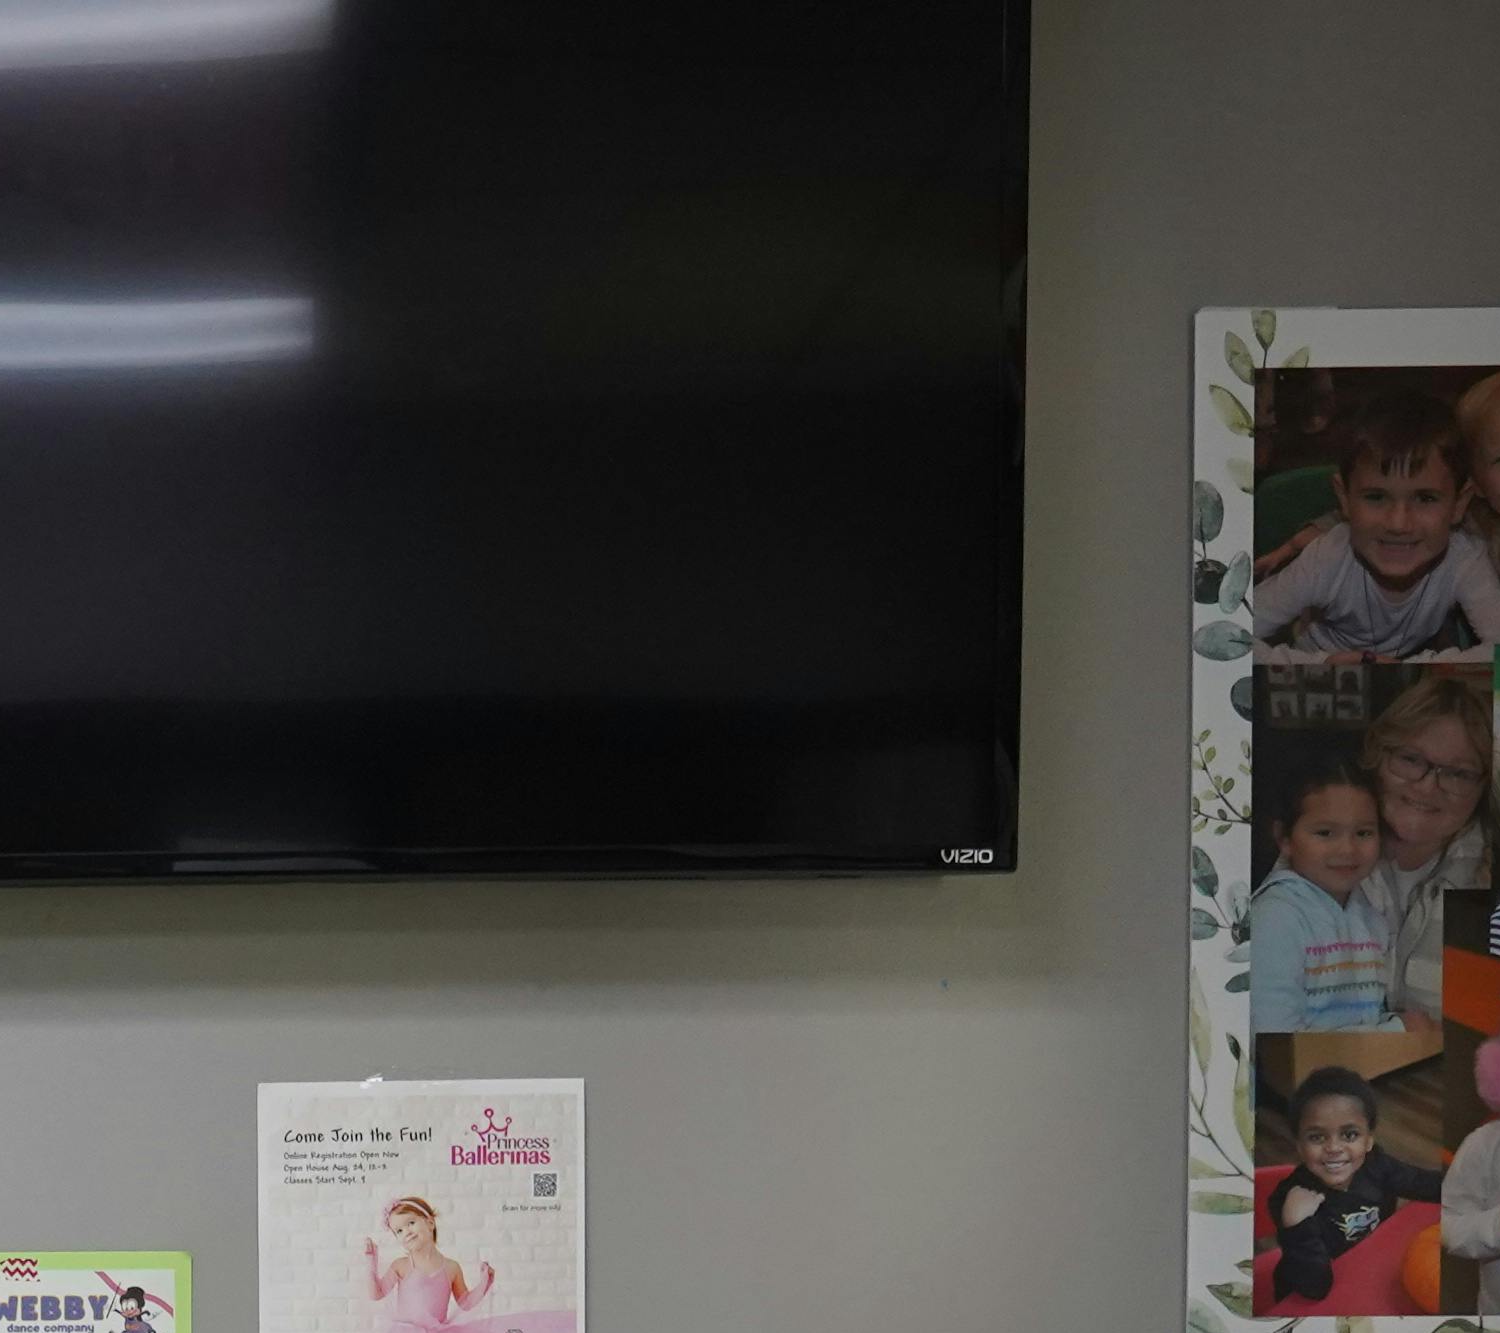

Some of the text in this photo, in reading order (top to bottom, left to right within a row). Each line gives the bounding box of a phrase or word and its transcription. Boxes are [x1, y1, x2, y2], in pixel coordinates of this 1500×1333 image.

[941, 849, 993, 863] VIZIO
[284, 1127, 433, 1143] Come Join the Fun!
[487, 1133, 550, 1150] Princess
[283, 1152, 308, 1160] Online
[310, 1151, 357, 1162] Registration
[360, 1151, 379, 1161] Open
[450, 1144, 552, 1166] Ballerinas
[283, 1164, 329, 1174] Open House
[283, 1176, 335, 1184] Classes Start
[7, 1323, 40, 1333] dance
